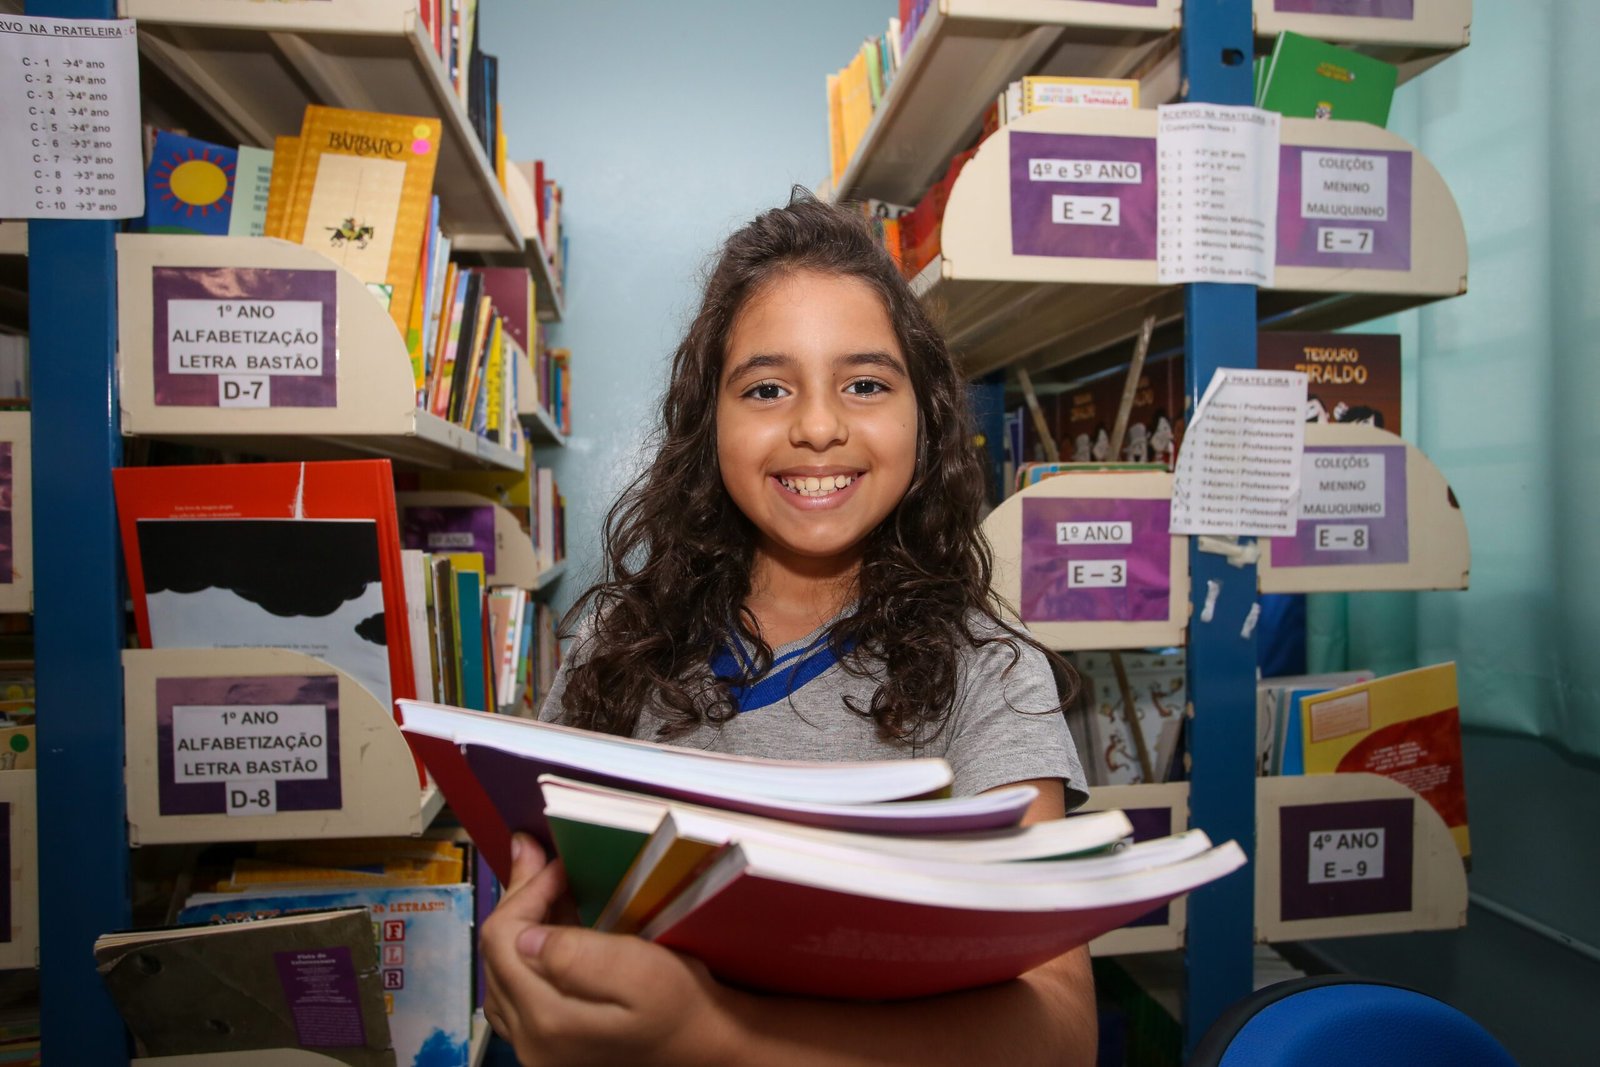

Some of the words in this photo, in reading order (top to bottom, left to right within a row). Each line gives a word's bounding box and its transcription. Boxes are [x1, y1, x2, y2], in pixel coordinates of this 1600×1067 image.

[30, 23, 47, 33] NA
[54, 26, 122, 36] PRATELEIRA
[22, 57, 30, 66] C
[45, 59, 49, 67] 1
[86, 61, 105, 69] ano
[25, 74, 33, 83] C
[46, 75, 52, 84] 2
[27, 91, 35, 99] C
[48, 91, 53, 99] 3
[89, 93, 108, 101] ano
[29, 107, 37, 115] C
[50, 107, 56, 115] 4
[91, 109, 109, 117] ano
[30, 123, 38, 132] C
[51, 123, 57, 132] 5
[92, 125, 110, 133] ano
[32, 138, 39, 147] C
[52, 139, 59, 148] 6
[33, 154, 41, 163] C
[54, 155, 60, 163] 7
[1318, 157, 1374, 171] COLEÇÕES
[34, 170, 42, 179] C
[55, 171, 61, 179] 8
[97, 172, 115, 180] ano
[1032, 163, 1052, 176] 4º
[1058, 166, 1067, 178] e
[1074, 164, 1091, 177] 5º
[1098, 165, 1137, 179] ANO
[35, 186, 43, 194] C
[56, 186, 62, 194] 9
[98, 188, 116, 196] ano
[1323, 181, 1370, 193] MENINO
[36, 201, 44, 209] C
[54, 202, 66, 210] 10
[1063, 202, 1074, 219] E
[1101, 204, 1112, 221] 2
[1306, 203, 1384, 217] MALUQUINHO
[1324, 232, 1334, 249] E
[1358, 232, 1369, 249] 7
[217, 305, 232, 318] 1º
[237, 305, 275, 319] ANO
[172, 328, 318, 347] ALFABETIZAÇÃO
[180, 355, 236, 369] LETRA
[247, 353, 318, 369] BASTÃO
[224, 382, 263, 400] D-7
[1314, 456, 1369, 470] COLEÇÕES
[1320, 480, 1366, 491] MENINO
[1304, 503, 1381, 514] MALUQUINHO
[1061, 527, 1078, 542] 1º
[1084, 525, 1123, 540] ANO
[1320, 529, 1329, 547] E
[1353, 529, 1364, 547] 8
[1074, 566, 1084, 584] E
[1112, 565, 1122, 583] 3
[221, 712, 236, 725] 1º
[241, 711, 278, 725] ANO
[178, 732, 322, 751] ALFABETIZAÇÃO
[185, 762, 241, 776] LETRA
[246, 757, 318, 774] BASTÃO
[231, 790, 270, 808] D-8
[1313, 834, 1331, 850] 4º
[1337, 832, 1378, 849] ANO
[1324, 862, 1335, 878] E
[1357, 861, 1367, 876] 9
[390, 924, 400, 938] F
[389, 948, 400, 962] L
[388, 972, 399, 986] R
